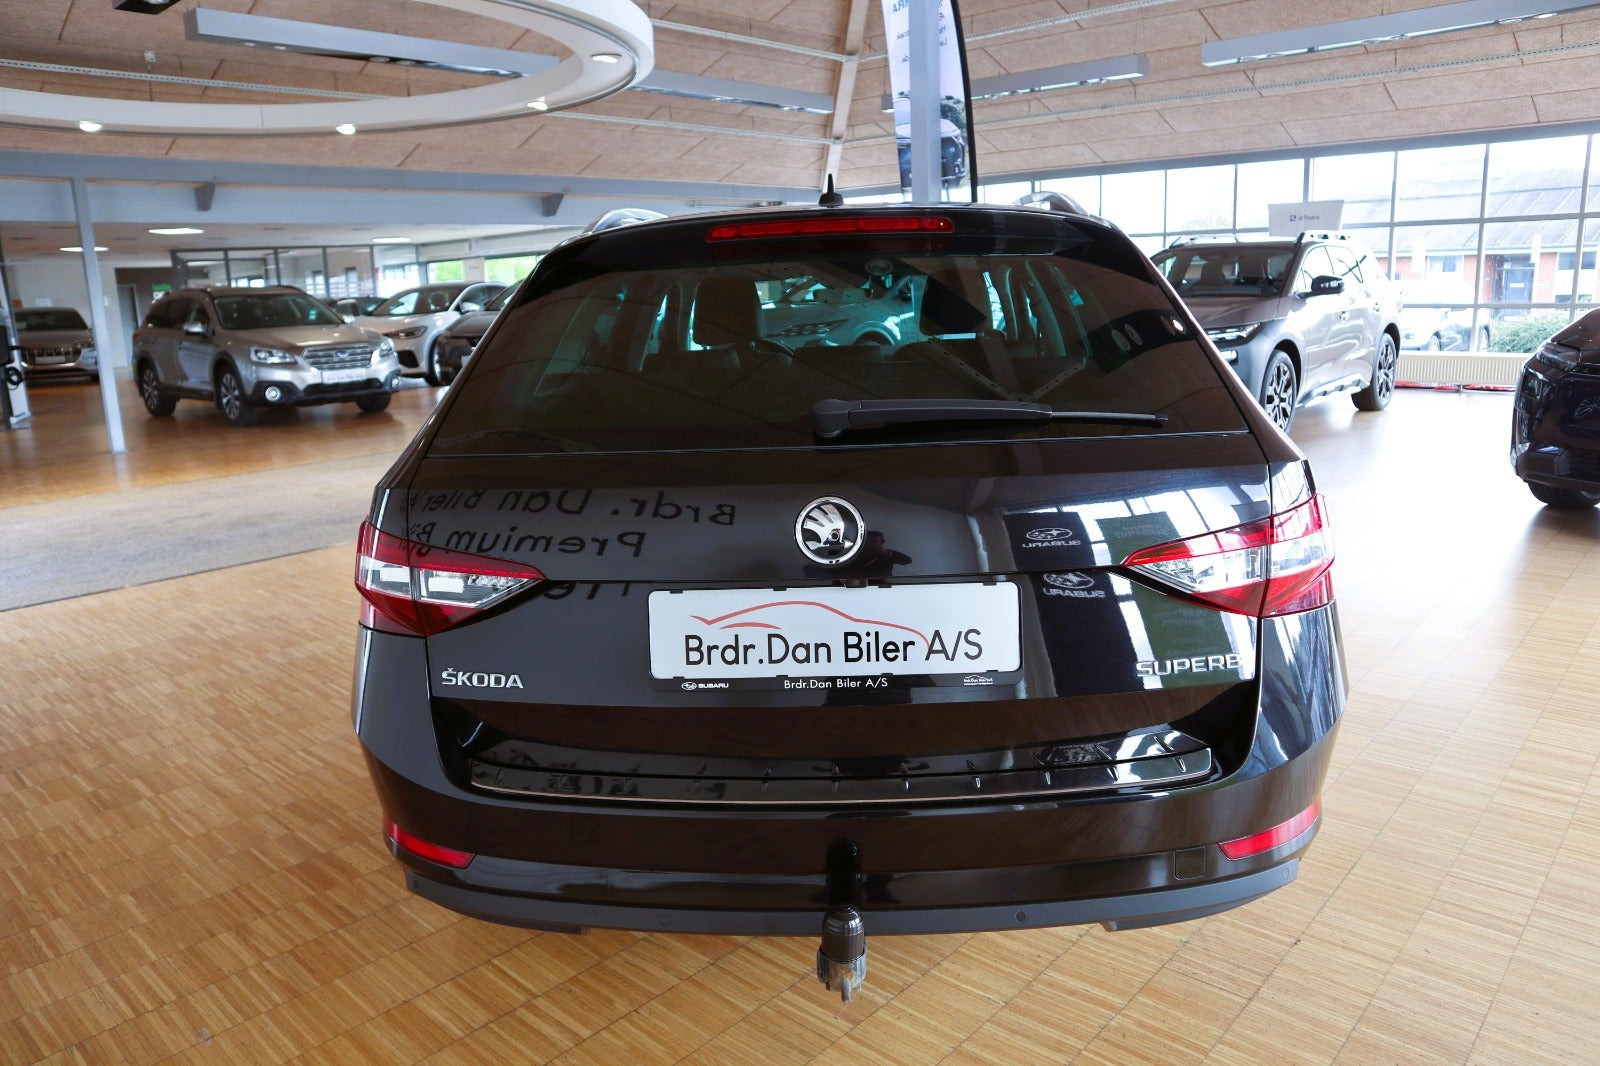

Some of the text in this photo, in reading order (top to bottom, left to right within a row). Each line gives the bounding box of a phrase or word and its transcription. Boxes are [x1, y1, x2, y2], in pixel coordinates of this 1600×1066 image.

[843, 631, 916, 663] Biler
[924, 628, 983, 662] A/S
[1136, 654, 1242, 678] SUPERB
[441, 667, 524, 689] ŠKODA
[836, 678, 861, 688] Biler
[865, 677, 888, 688] A/S
